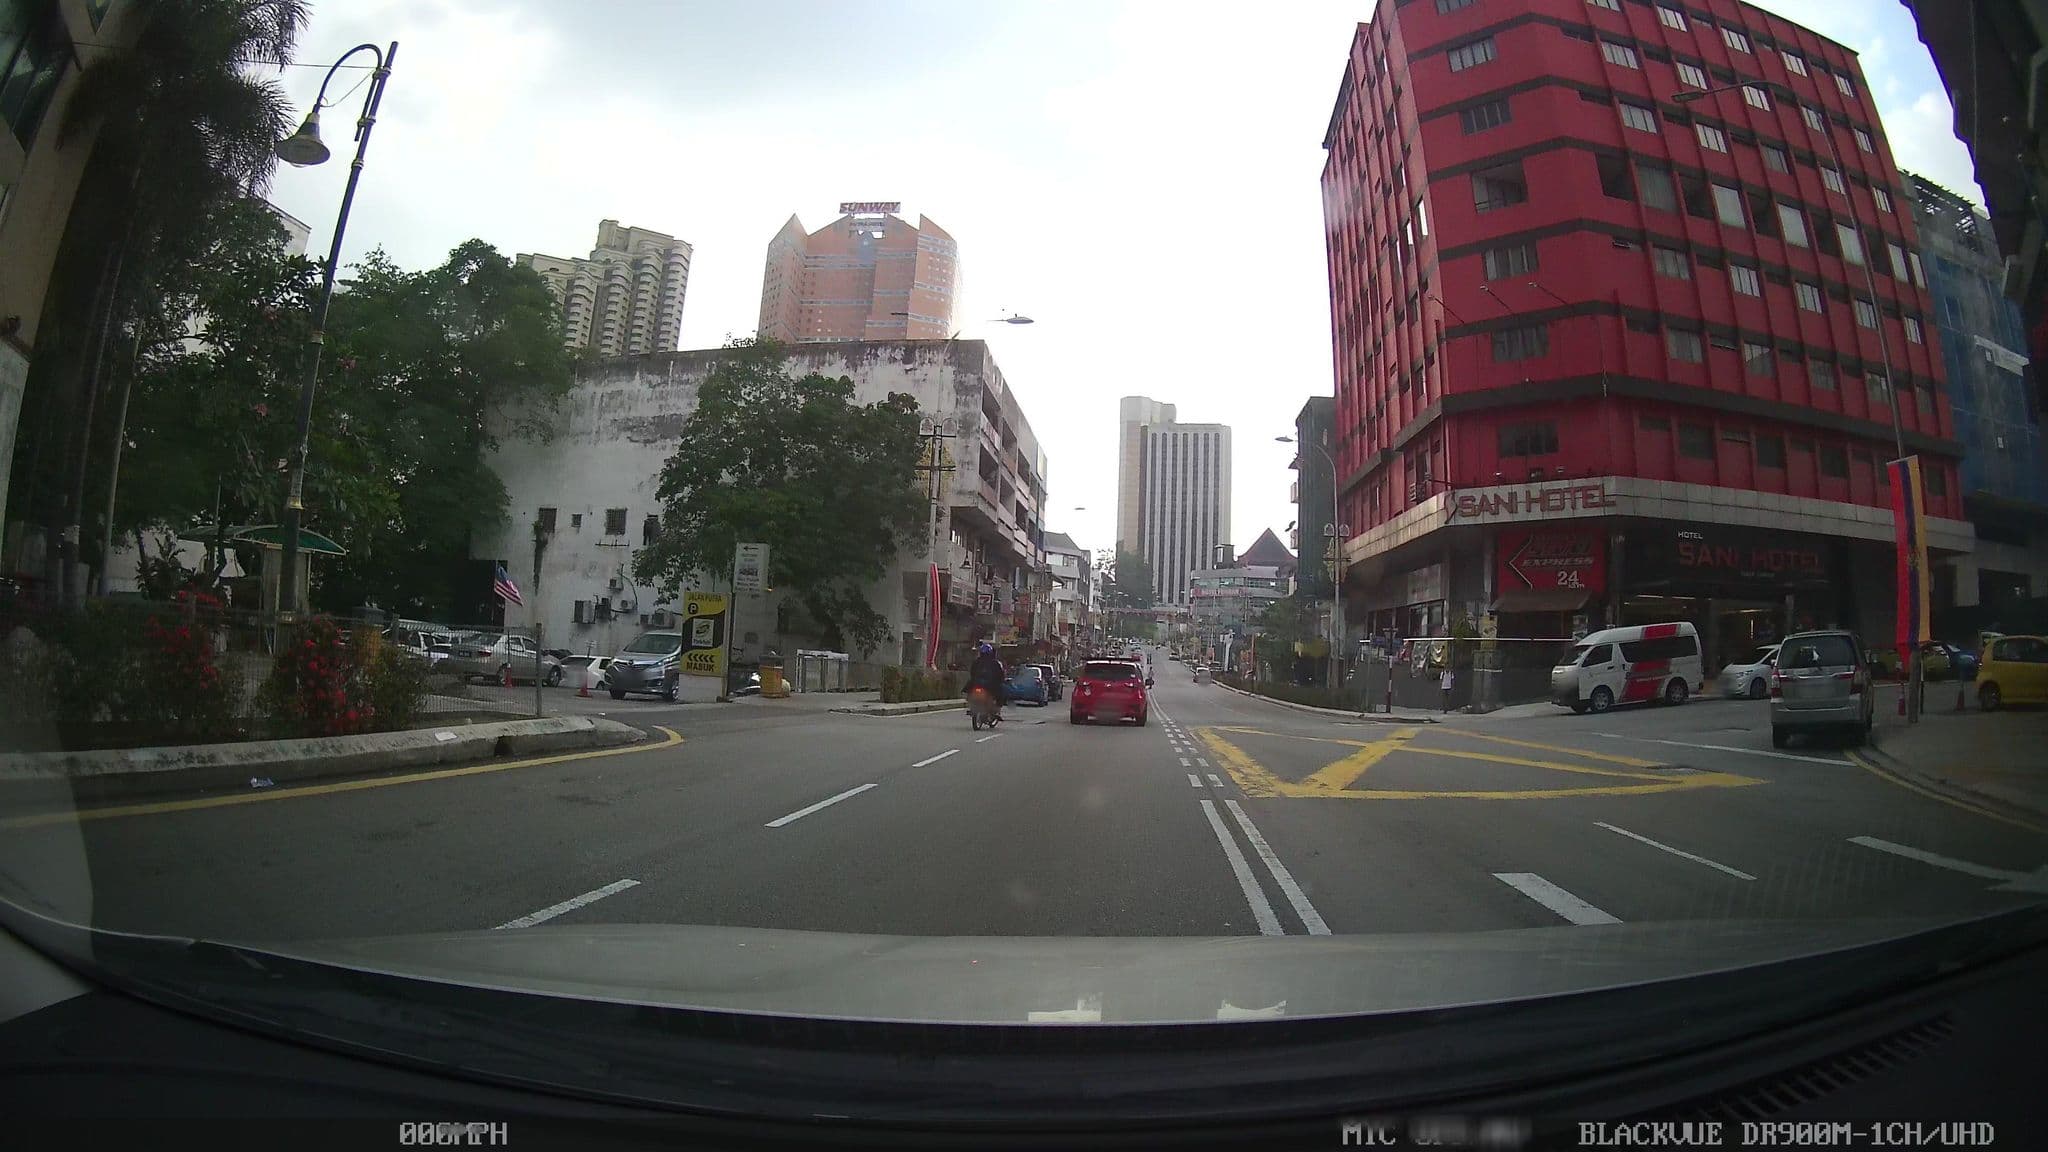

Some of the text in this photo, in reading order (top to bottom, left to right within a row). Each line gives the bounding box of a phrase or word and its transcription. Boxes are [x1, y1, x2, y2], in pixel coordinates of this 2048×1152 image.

[839, 202, 900, 214] SUNWAY
[1458, 484, 1616, 517] SANI HOTEL
[1678, 531, 1704, 540] HOTEL
[1521, 557, 1595, 567] EXPRESS
[1678, 543, 1825, 575] SANI HOTEL
[1557, 570, 1580, 586] 24
[686, 662, 715, 672] MASUK
